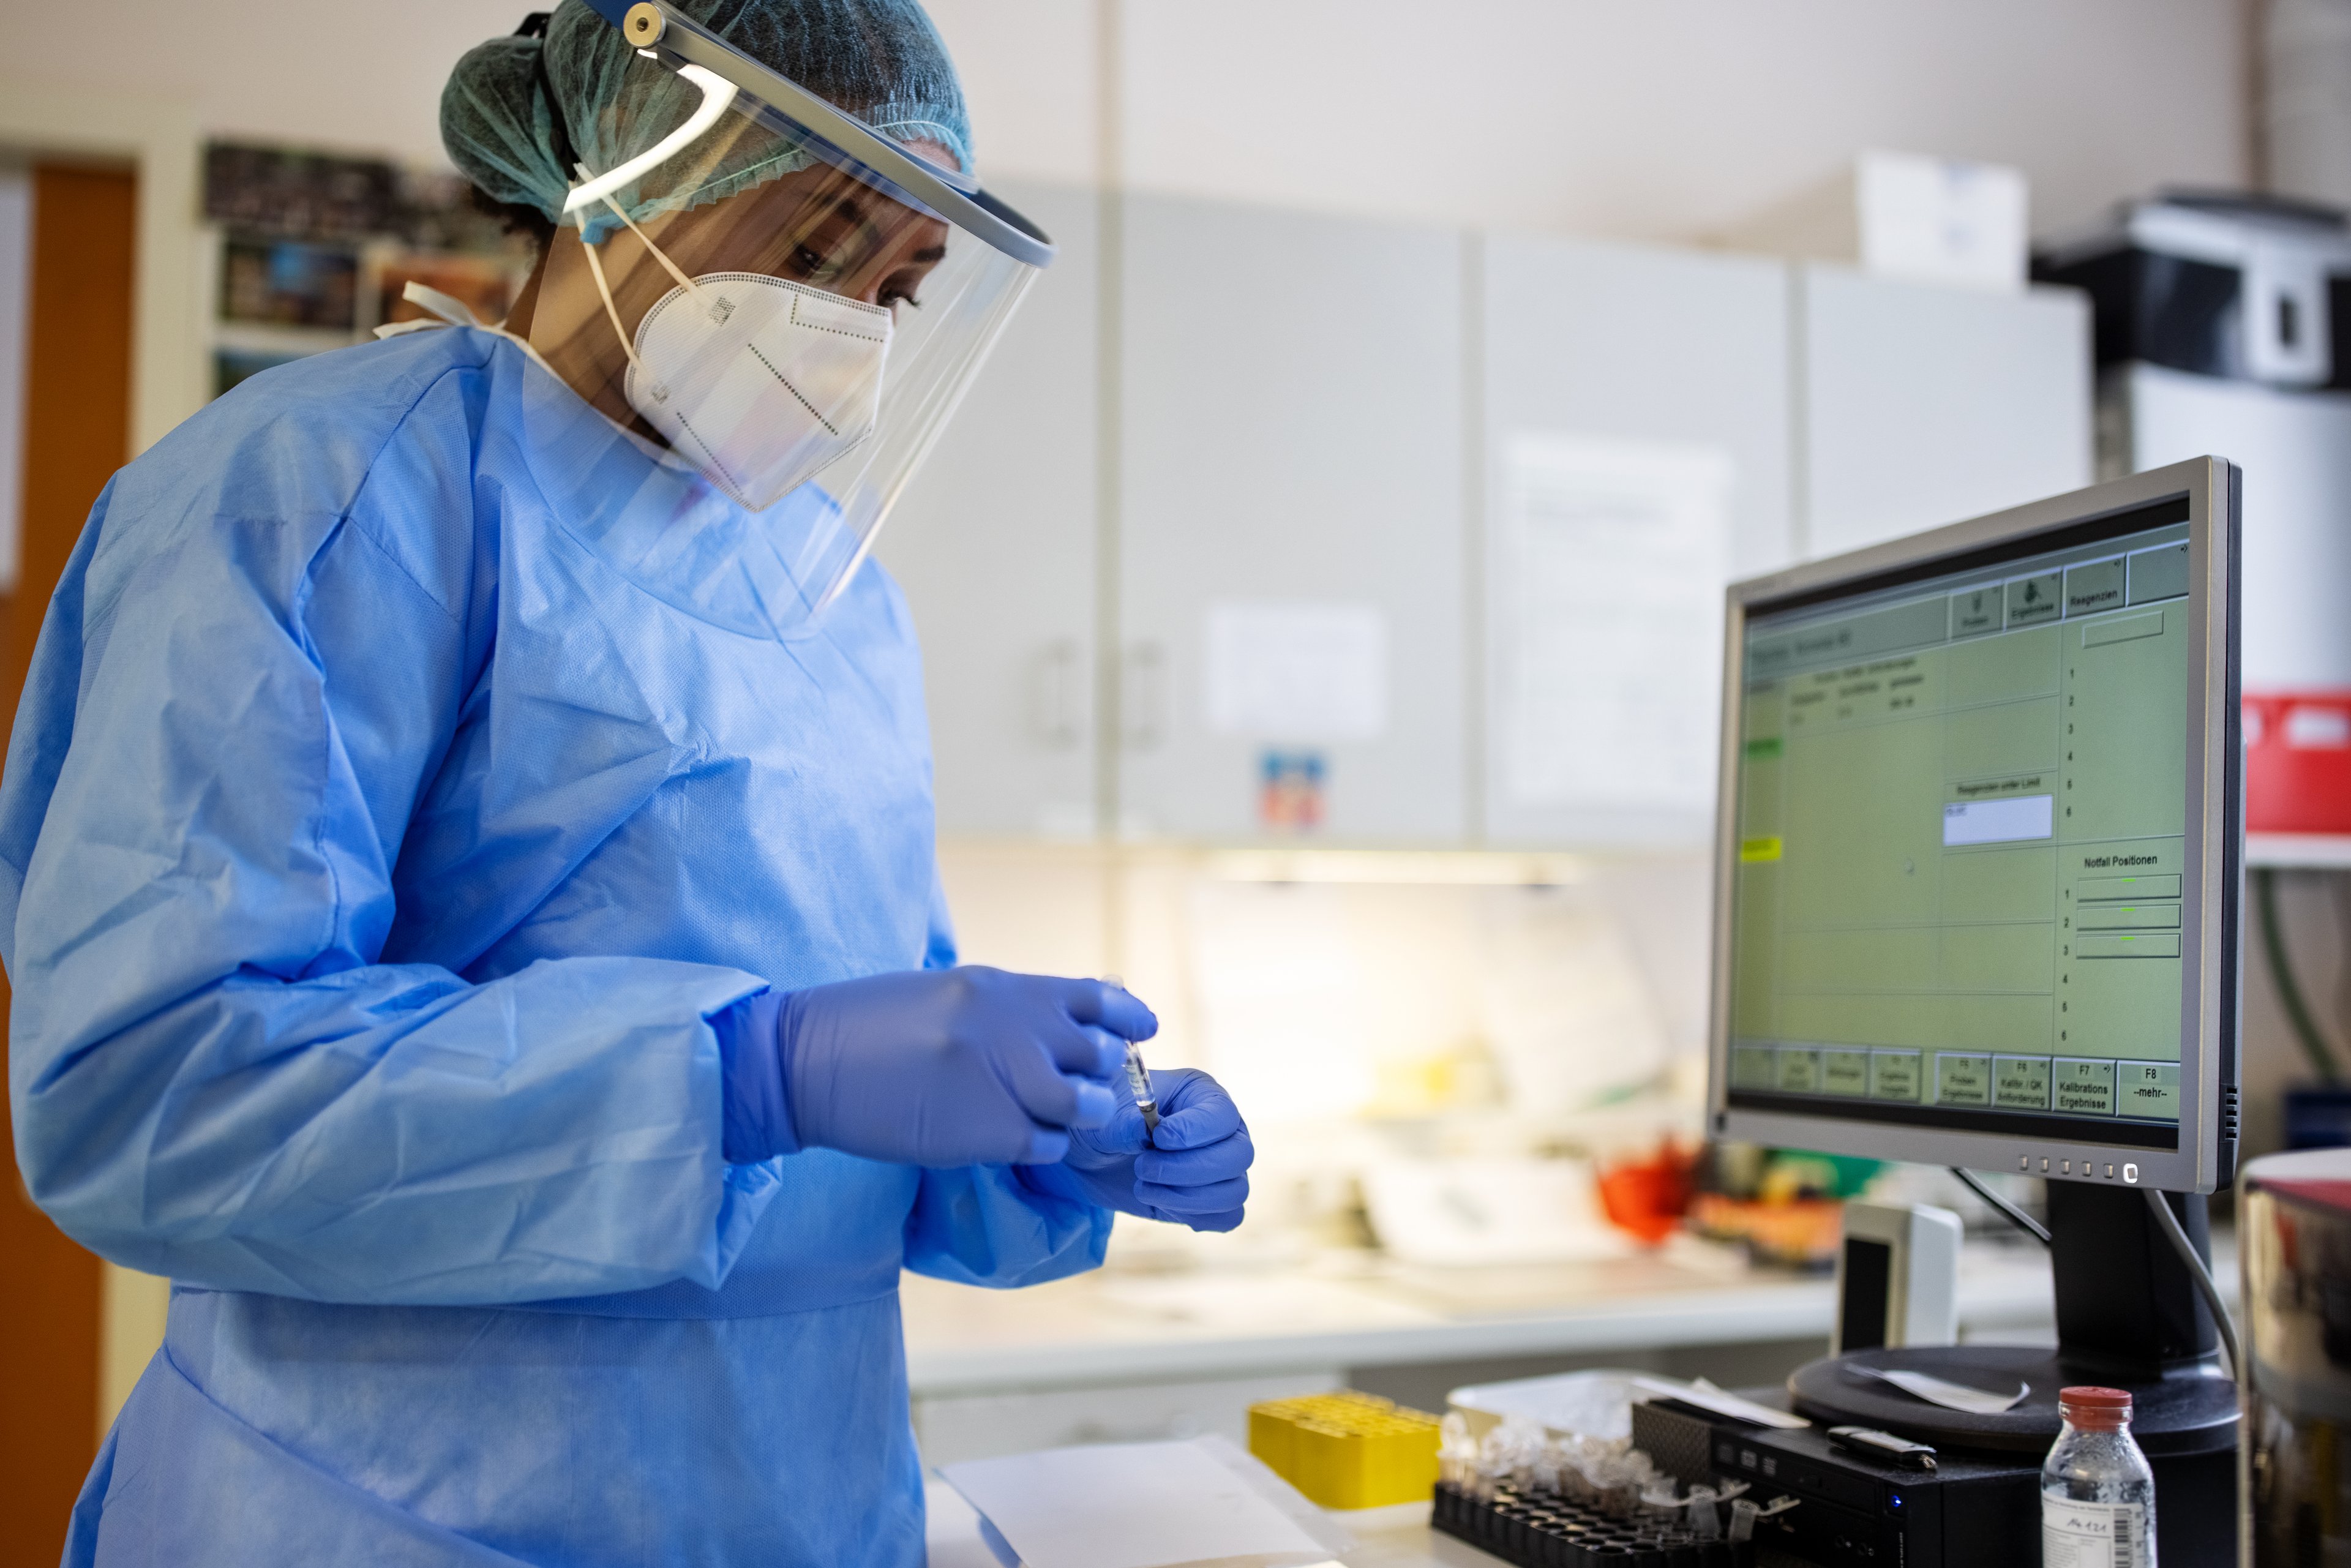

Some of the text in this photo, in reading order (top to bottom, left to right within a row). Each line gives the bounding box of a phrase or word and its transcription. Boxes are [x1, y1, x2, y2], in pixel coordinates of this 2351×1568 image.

[2070, 590, 2118, 608] Reagenzien
[2068, 694, 2074, 707] 2
[2068, 722, 2074, 735] 3
[2067, 750, 2073, 761] 4
[2085, 855, 2158, 868] Notfall Positionen
[2063, 916, 2069, 928] 2
[2063, 944, 2069, 956] 3
[2062, 973, 2068, 984] 4
[2079, 1065, 2090, 1076] F7
[2145, 1068, 2156, 1079] F8
[2059, 1082, 2109, 1095] Kalibrations
[2060, 1096, 2107, 1109] Ergebnisse
